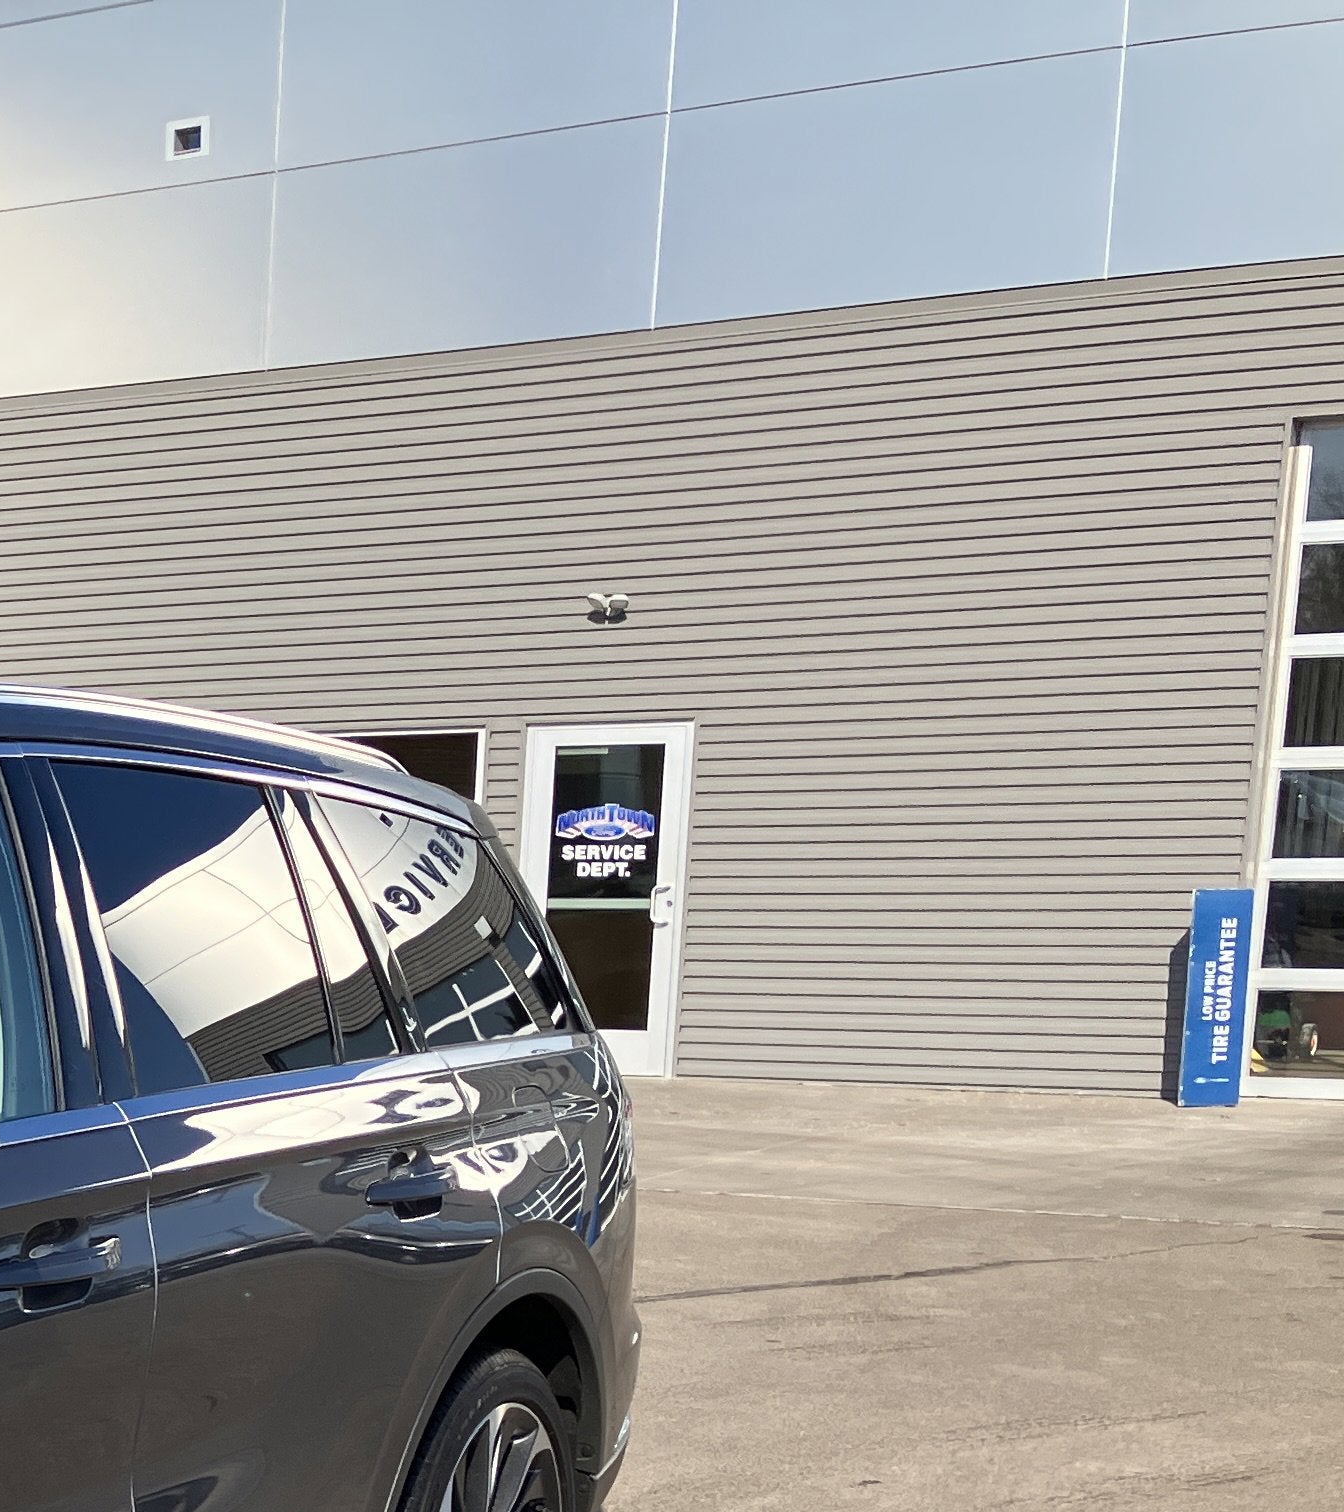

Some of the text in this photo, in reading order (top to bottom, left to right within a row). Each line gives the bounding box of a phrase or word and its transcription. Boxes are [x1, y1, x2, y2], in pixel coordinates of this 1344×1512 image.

[561, 844, 647, 861] SERVICE
[576, 861, 631, 878] DEPT.
[1201, 960, 1216, 1021] LOW PRICE
[1211, 917, 1238, 1065] TIRE GUARANTEE
